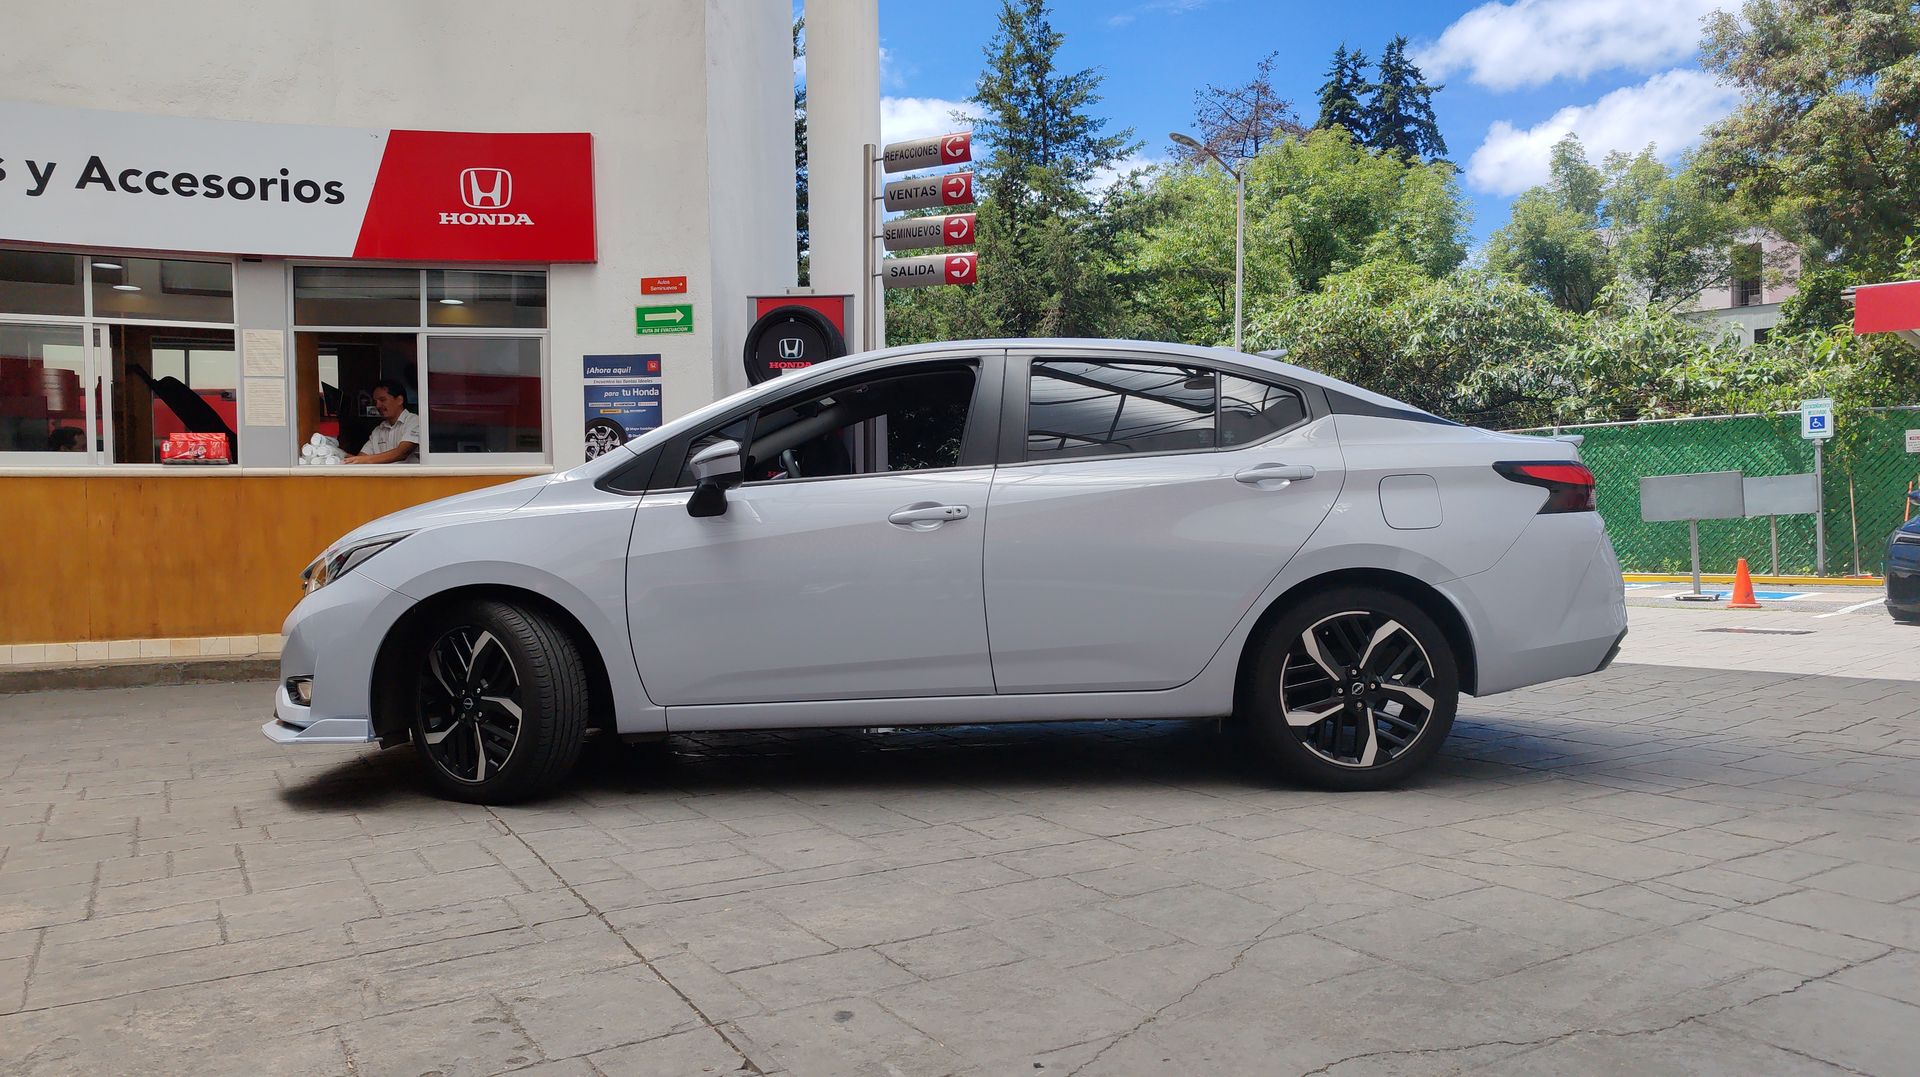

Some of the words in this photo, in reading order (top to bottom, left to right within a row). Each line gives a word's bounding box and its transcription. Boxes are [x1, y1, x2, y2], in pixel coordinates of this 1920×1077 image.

[884, 143, 938, 162] REFACCIONES
[25, 159, 57, 197] y
[75, 155, 345, 205] Accesorios
[889, 185, 937, 201] VENTAS
[438, 212, 535, 226] HONDA
[885, 224, 941, 240] SEMINUEVOS
[890, 264, 935, 278] SALIDA
[586, 366, 612, 375] ¡Ahora
[612, 366, 632, 375] aquí!
[622, 388, 631, 397] tu
[632, 387, 660, 397] Honda
